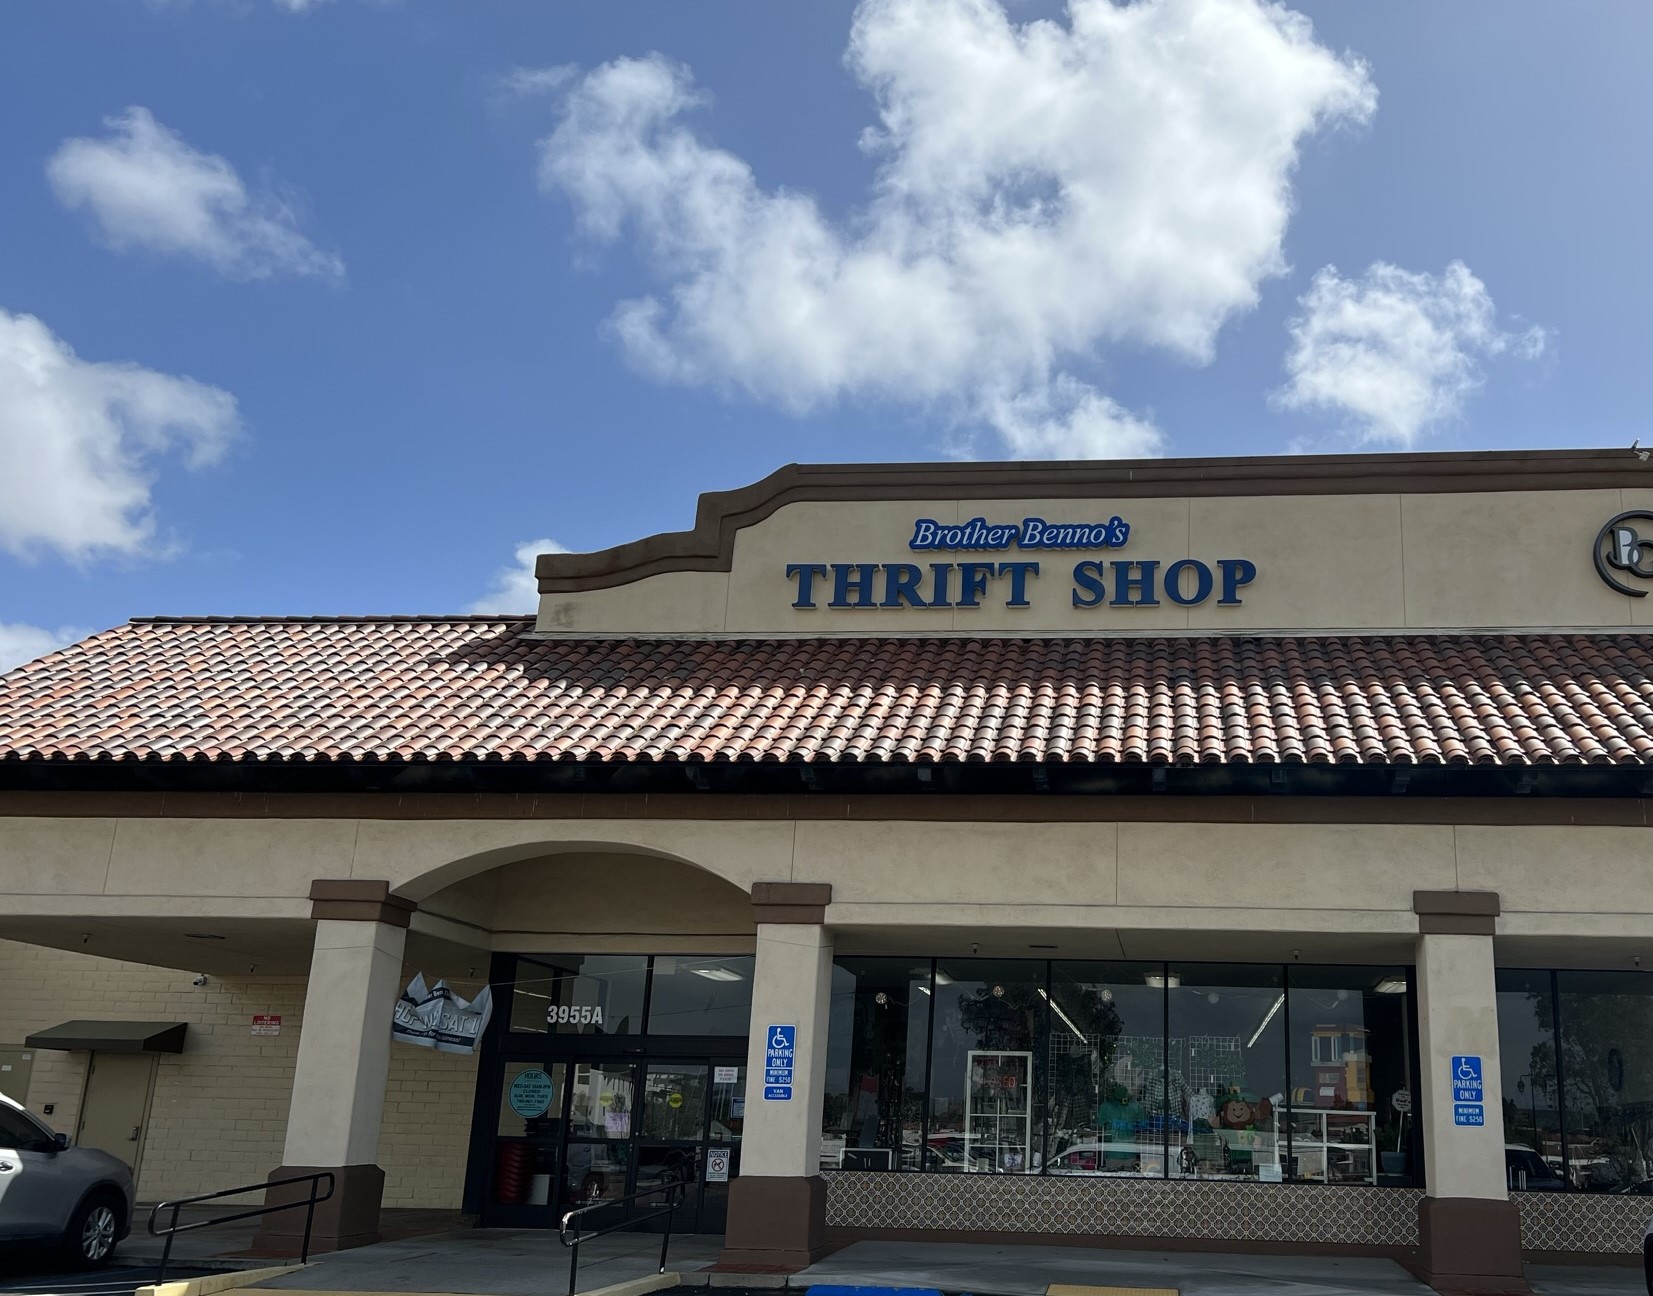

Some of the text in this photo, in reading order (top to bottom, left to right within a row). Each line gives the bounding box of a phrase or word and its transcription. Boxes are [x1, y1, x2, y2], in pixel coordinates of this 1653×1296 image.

[914, 519, 1126, 547] Brother Benno's
[785, 559, 1257, 609] THRIFT SHOP
[547, 1005, 603, 1024] 3955A
[768, 1048, 792, 1057] PARKING
[771, 1058, 788, 1067] ONLY
[778, 1076, 791, 1084] $250
[1454, 1080, 1481, 1089] PARKING
[1459, 1090, 1477, 1100] ONLY
[1469, 1115, 1483, 1123] $250
